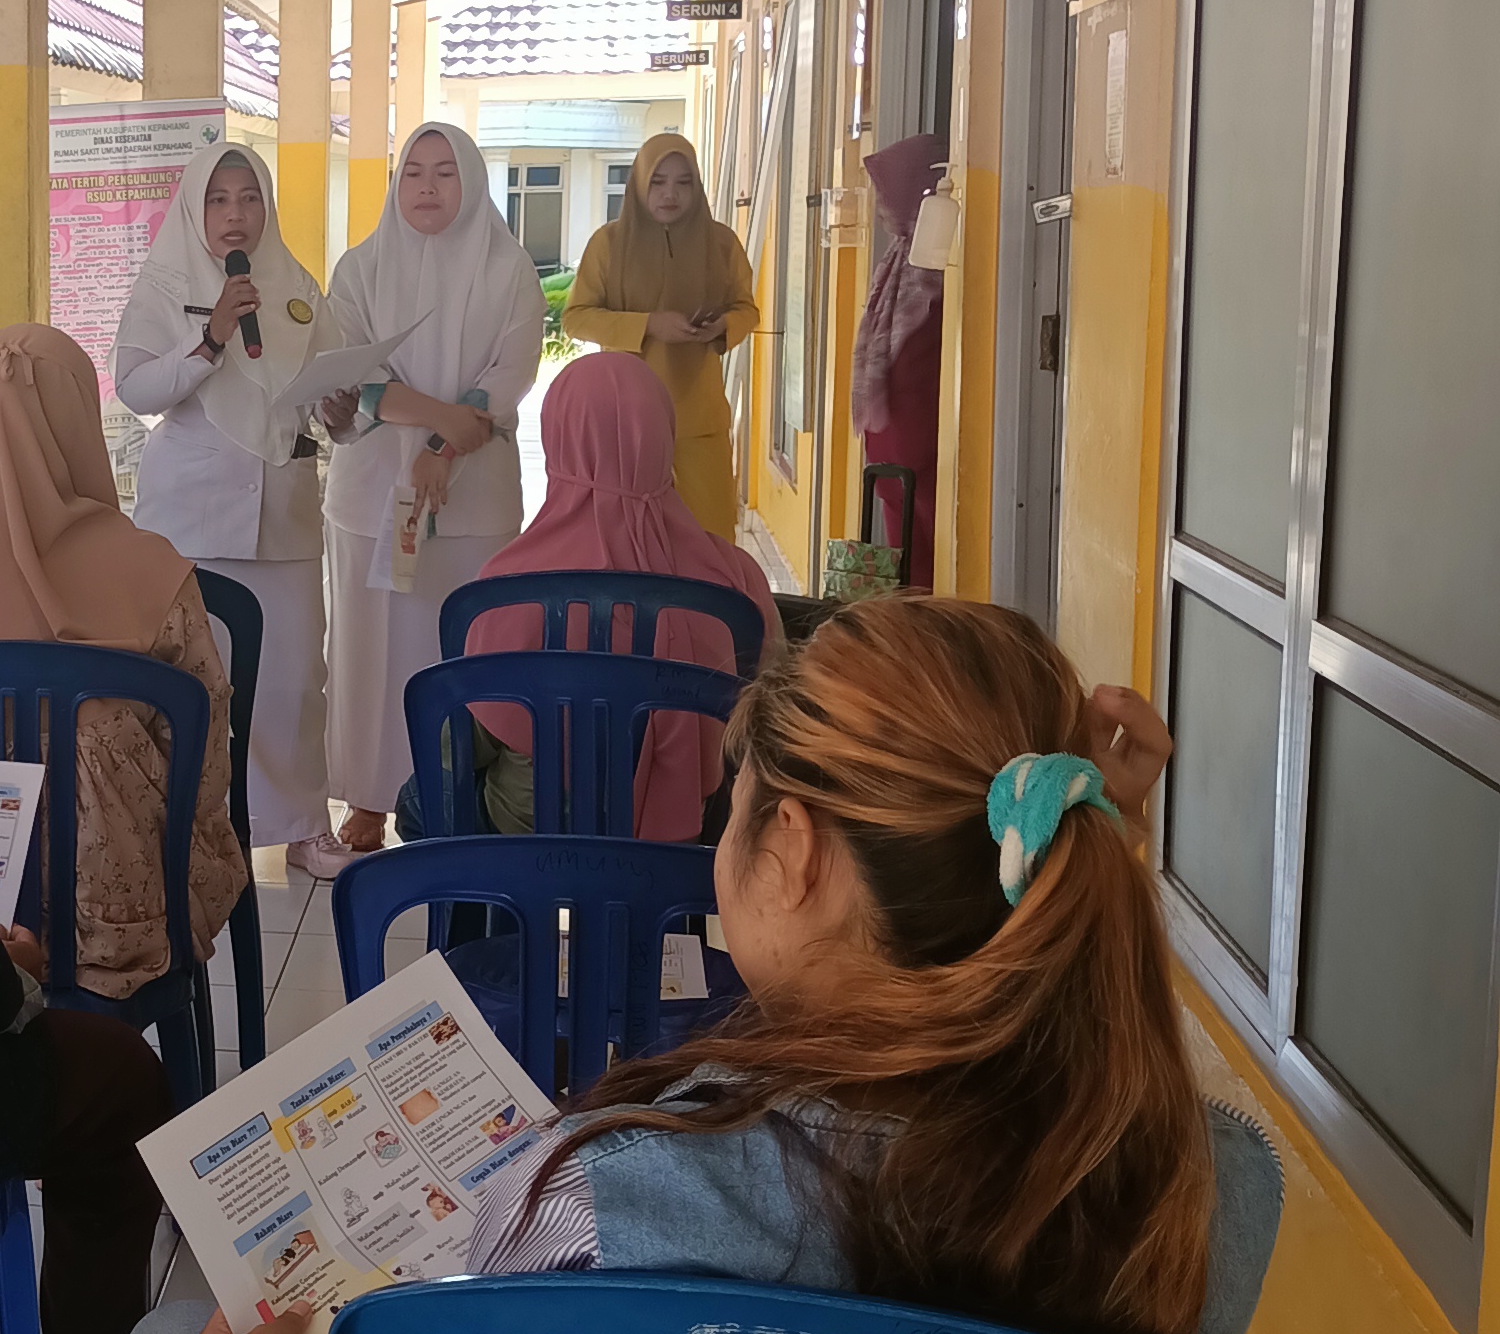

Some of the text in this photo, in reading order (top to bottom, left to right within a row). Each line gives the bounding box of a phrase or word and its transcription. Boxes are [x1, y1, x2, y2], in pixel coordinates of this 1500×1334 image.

[671, 2, 738, 18] SERUNI 4
[654, 53, 706, 65] SERUNI 5
[55, 121, 189, 138] PEMERINTAH KABUPATEN KEPAHIANG
[93, 133, 151, 145] DINAS KESEHATAN
[53, 149, 78, 157] RUMAH
[80, 147, 99, 155] SAKIT
[101, 146, 122, 154] UMUM
[123, 144, 150, 152] DAERAH
[153, 141, 192, 151] KEPAHIANG
[71, 175, 104, 188] TERTIB
[107, 171, 172, 186] PENGUNJUNG
[86, 186, 169, 202] RSUD KEPAHIANG
[376, 1038, 393, 1053] Apa
[288, 1079, 329, 1110] Tanda-Tanda
[229, 1131, 248, 1148] Diare
[489, 1154, 509, 1170] Diare
[252, 1208, 295, 1241] Bahaya Diare
